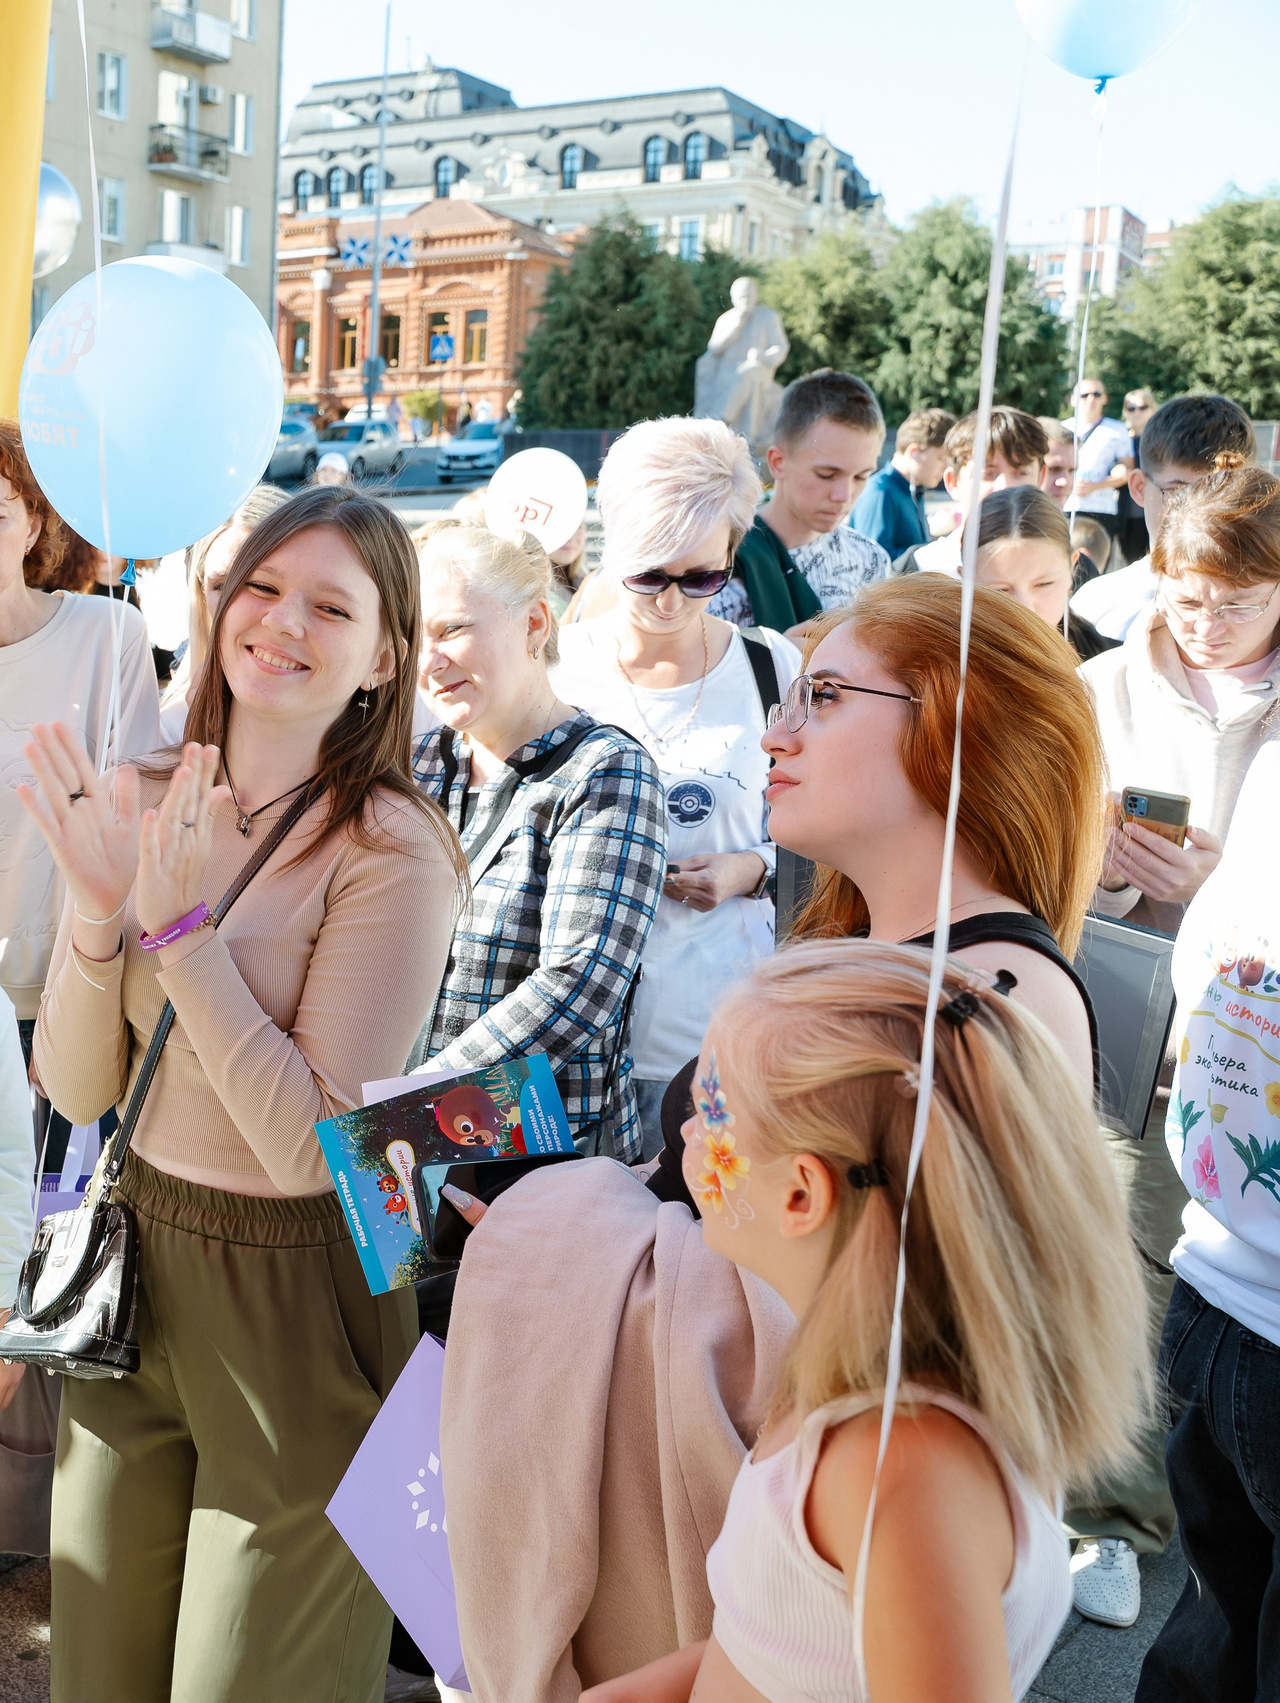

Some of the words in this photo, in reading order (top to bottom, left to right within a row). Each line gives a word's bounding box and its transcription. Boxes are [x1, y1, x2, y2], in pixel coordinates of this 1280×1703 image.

[528, 1109, 544, 1145] СВОИМИ
[529, 1084, 554, 1152] ПЕРСОНАЖАМИ
[547, 1114, 563, 1152] РИРОДЕ!
[396, 1149, 414, 1187] истории
[337, 1170, 355, 1208] ТЕТРАДЬ
[349, 1207, 368, 1248] РАБОЧАЯ
